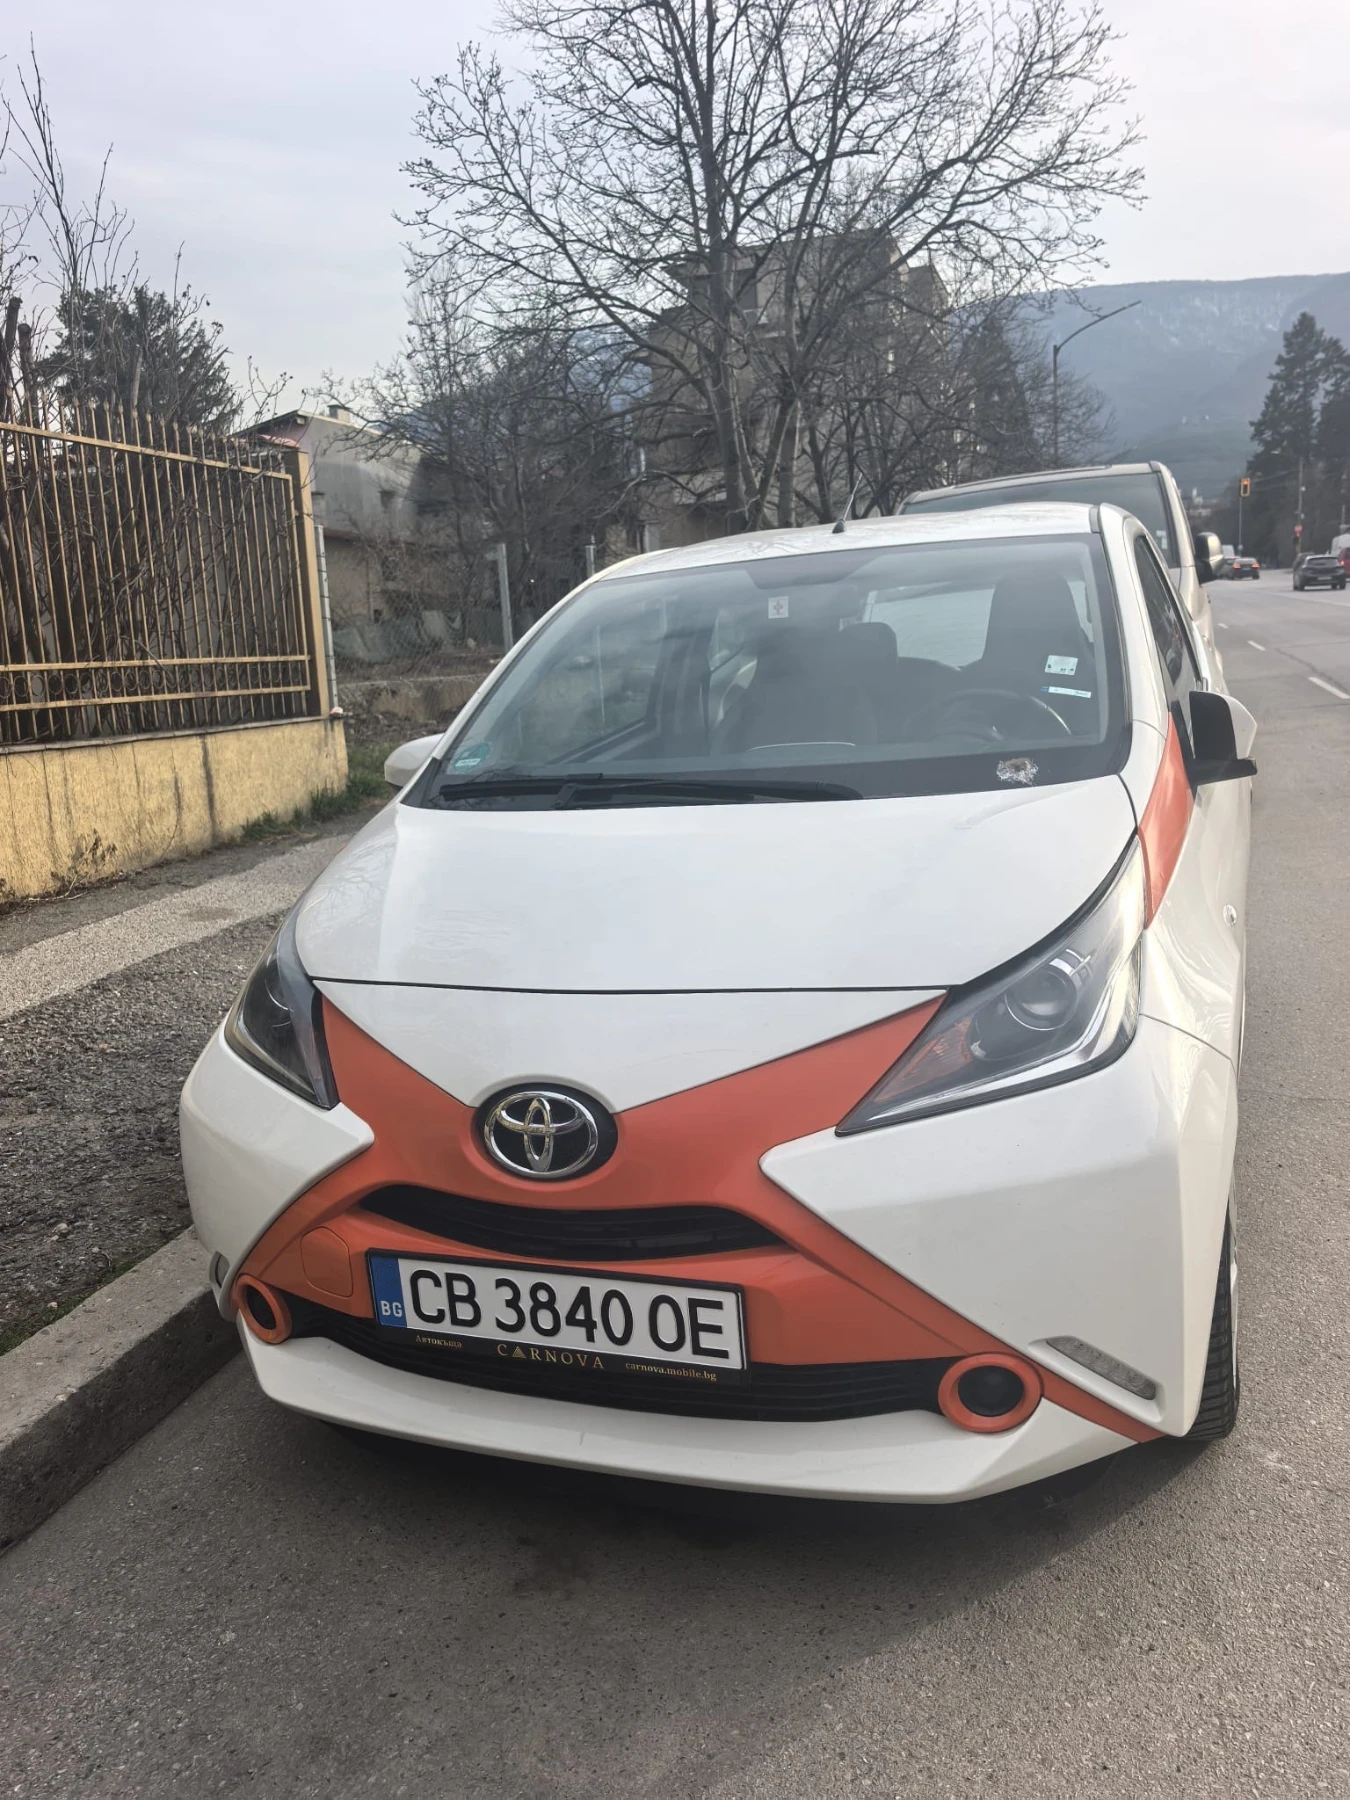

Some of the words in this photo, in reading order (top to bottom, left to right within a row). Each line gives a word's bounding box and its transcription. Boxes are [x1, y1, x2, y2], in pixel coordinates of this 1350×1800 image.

[381, 1300, 403, 1318] BG
[410, 1269, 482, 1328] CB
[495, 1278, 634, 1347] 3840
[648, 1294, 730, 1359] OE
[415, 1335, 463, 1349] Автокъща
[497, 1343, 605, 1369] CARNOVA
[625, 1362, 718, 1382] carnova.mobile.bg
